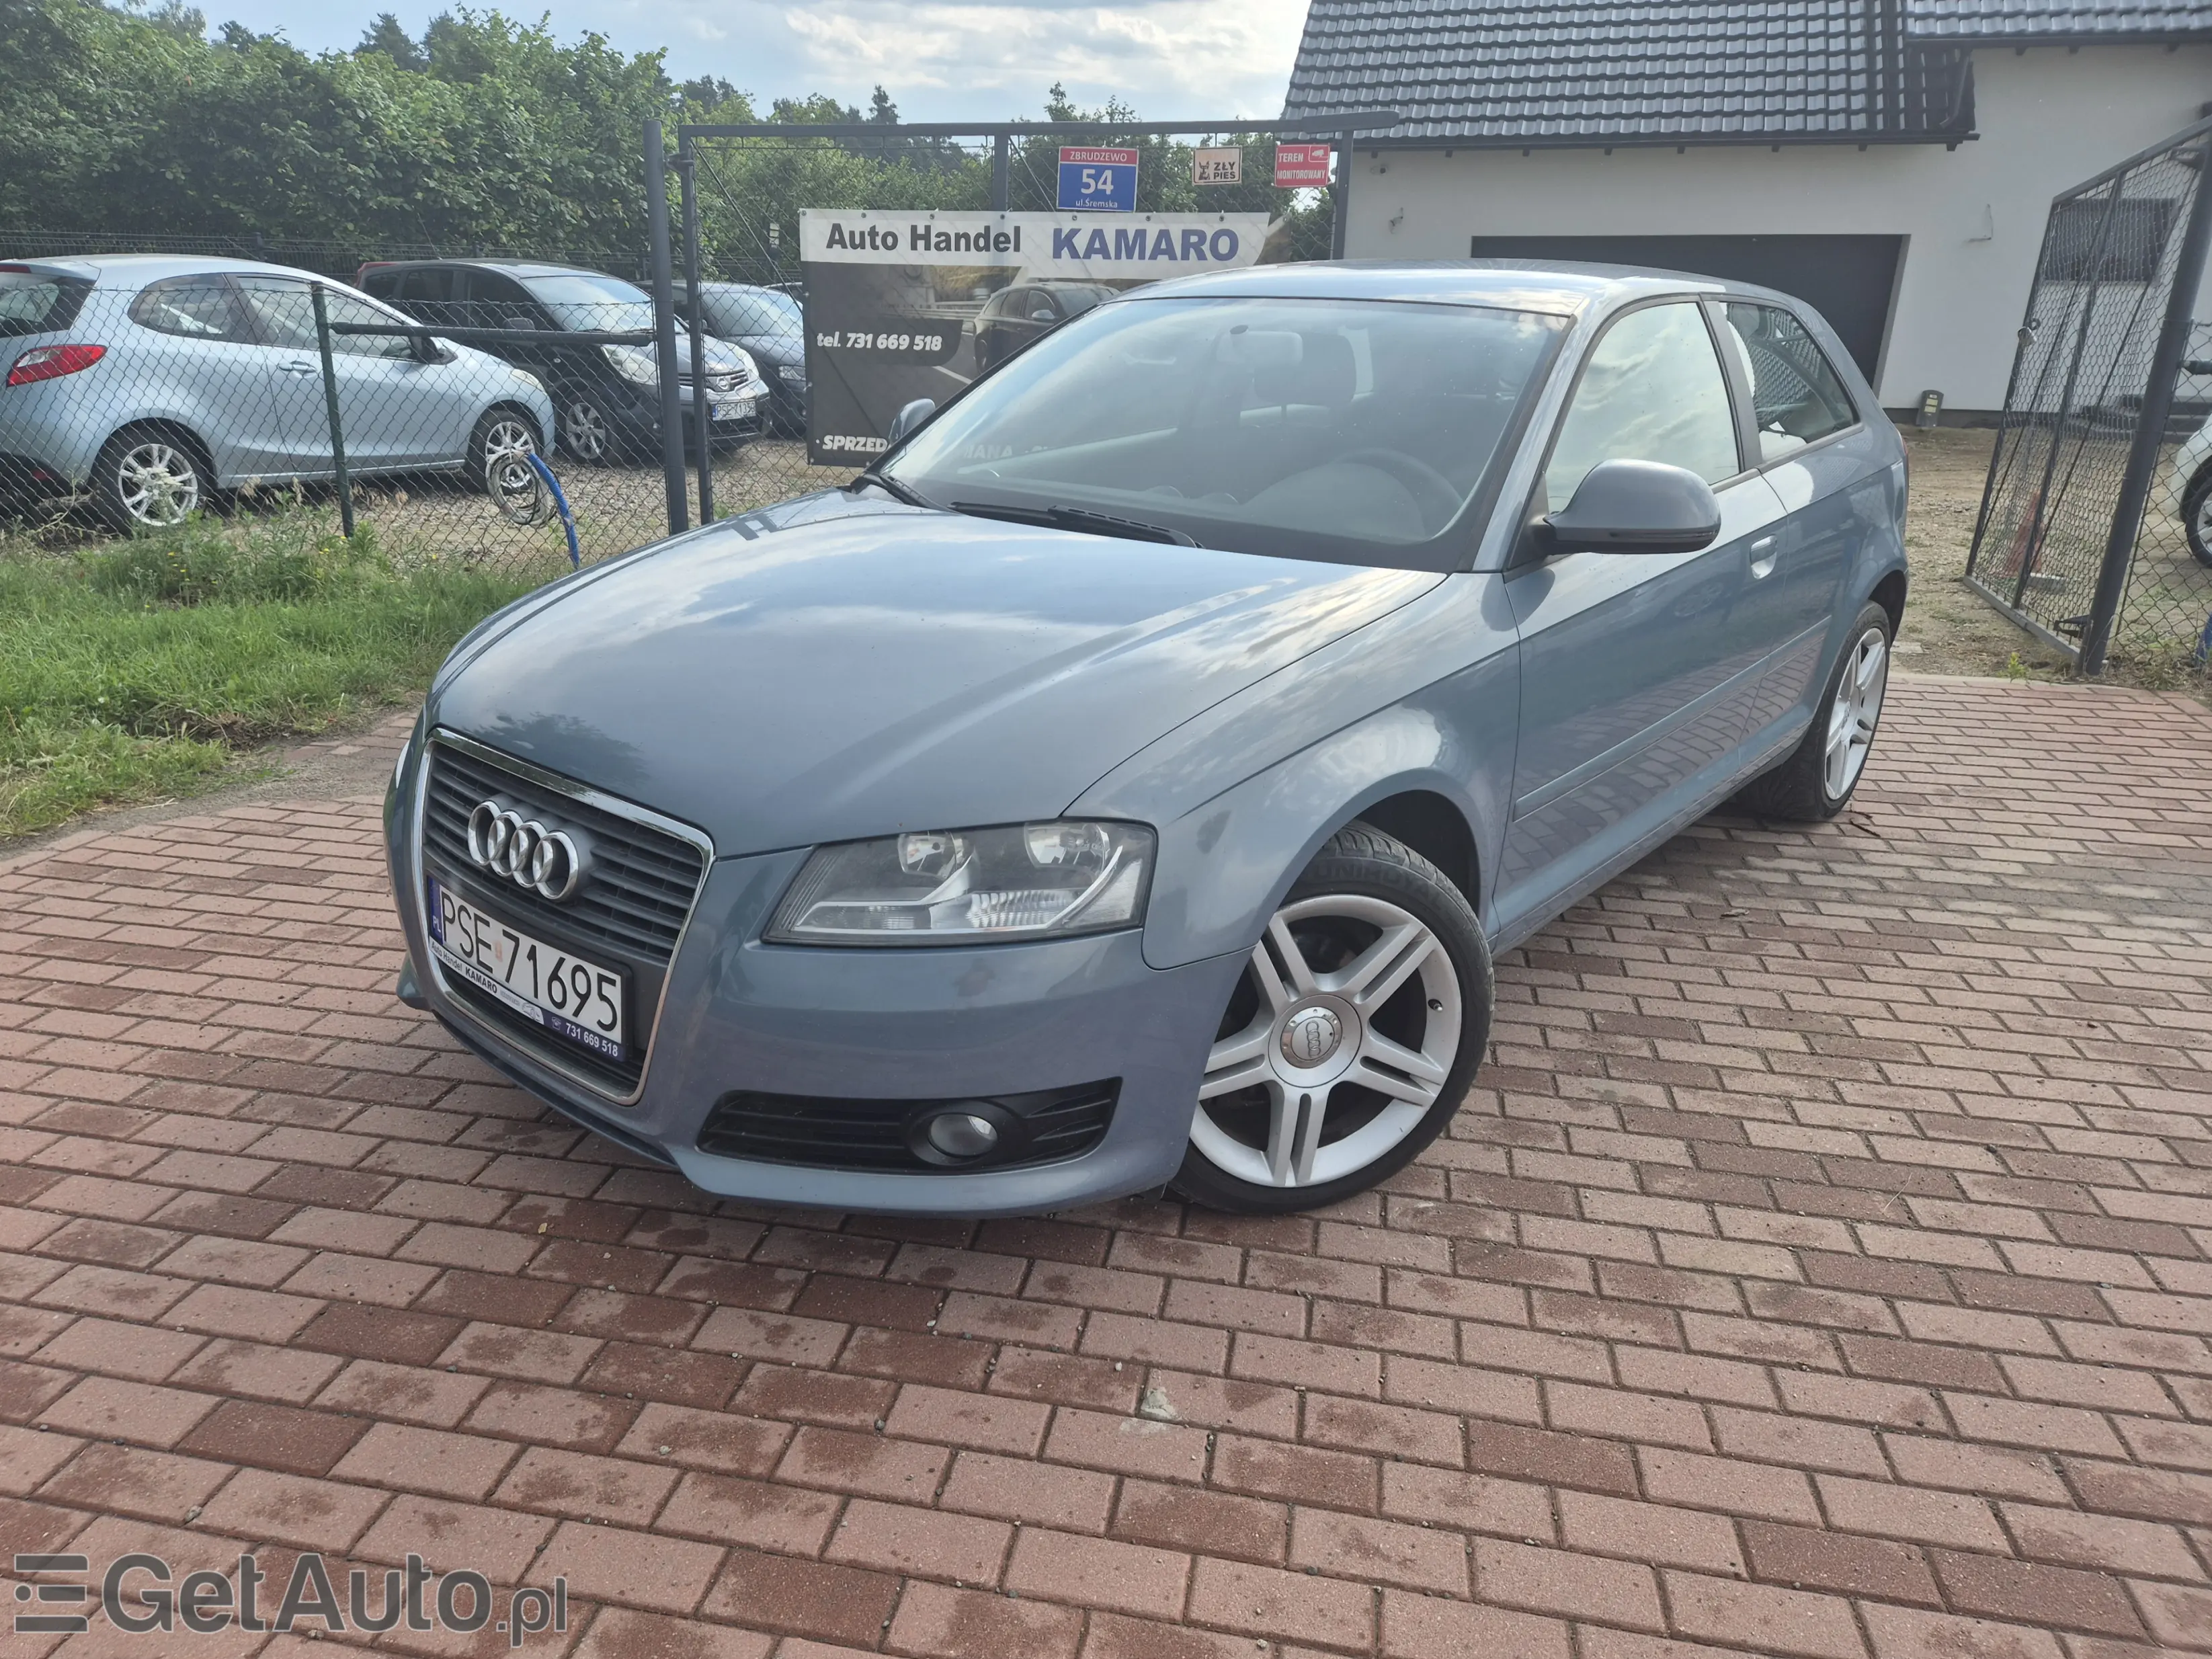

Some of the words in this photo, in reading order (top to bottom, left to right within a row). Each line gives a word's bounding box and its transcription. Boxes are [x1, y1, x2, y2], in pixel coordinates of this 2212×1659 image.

[1069, 151, 1127, 161] ZBRUDZEWO
[1278, 153, 1303, 162] TEREN
[1213, 162, 1236, 170] ZŁY
[1213, 171, 1236, 179] PIES
[1277, 169, 1325, 179] MONITOROWANY
[1081, 169, 1114, 194] 54
[826, 223, 899, 251] Auto
[910, 225, 1021, 253] Handel
[1052, 227, 1239, 261] KAMARO
[817, 331, 841, 347] tel.
[846, 333, 873, 348] 731
[876, 333, 909, 350] 669
[913, 335, 942, 351] 518
[822, 434, 891, 452] SPRZED
[431, 942, 442, 956] Auto
[443, 950, 462, 972] Handel
[465, 966, 497, 994] KAMARO
[432, 915, 441, 933] PL
[441, 890, 493, 974] PSE
[502, 929, 617, 1031] 71695
[565, 1022, 581, 1039] 731
[583, 1031, 600, 1048] 669
[602, 1039, 618, 1057] 518
